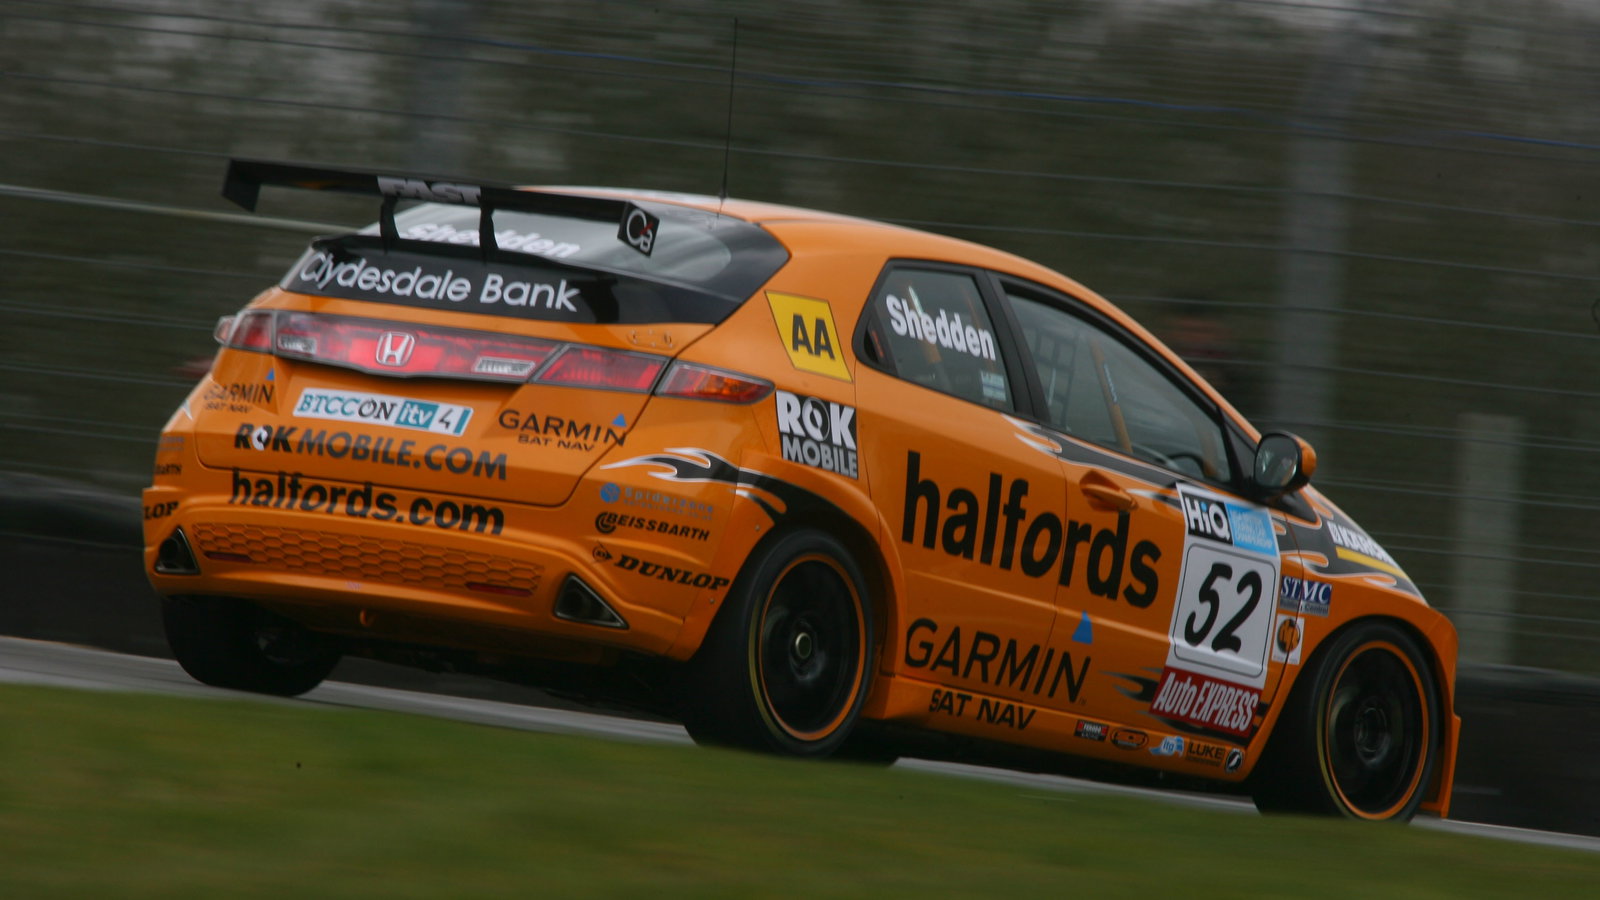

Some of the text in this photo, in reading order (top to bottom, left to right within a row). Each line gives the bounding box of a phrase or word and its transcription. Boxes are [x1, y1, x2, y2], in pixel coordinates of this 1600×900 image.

[377, 176, 481, 204] FAST
[299, 251, 580, 313] Clydesdale Bank
[792, 313, 835, 360] AA
[886, 294, 996, 361] Shedden
[204, 383, 275, 405] GARMIN
[399, 402, 432, 426] itv
[438, 408, 453, 430] 4
[499, 409, 627, 447] GARMIN
[518, 433, 595, 452] SAT NAV
[776, 391, 856, 451] ROK
[782, 433, 859, 479] MOBILE
[230, 468, 505, 535] halfords.com
[1184, 495, 1231, 541] HiQ
[606, 511, 710, 541] BEISSBARTH
[901, 449, 1162, 609] halfords
[614, 554, 730, 590] DUNLOP
[1281, 576, 1332, 605] STMC
[1184, 562, 1262, 654] 52
[904, 618, 1091, 704] GARMIN
[928, 688, 1037, 730] SAT NAV
[1153, 671, 1259, 732] Auto EXPRESS
[1188, 742, 1226, 760] LUKE
